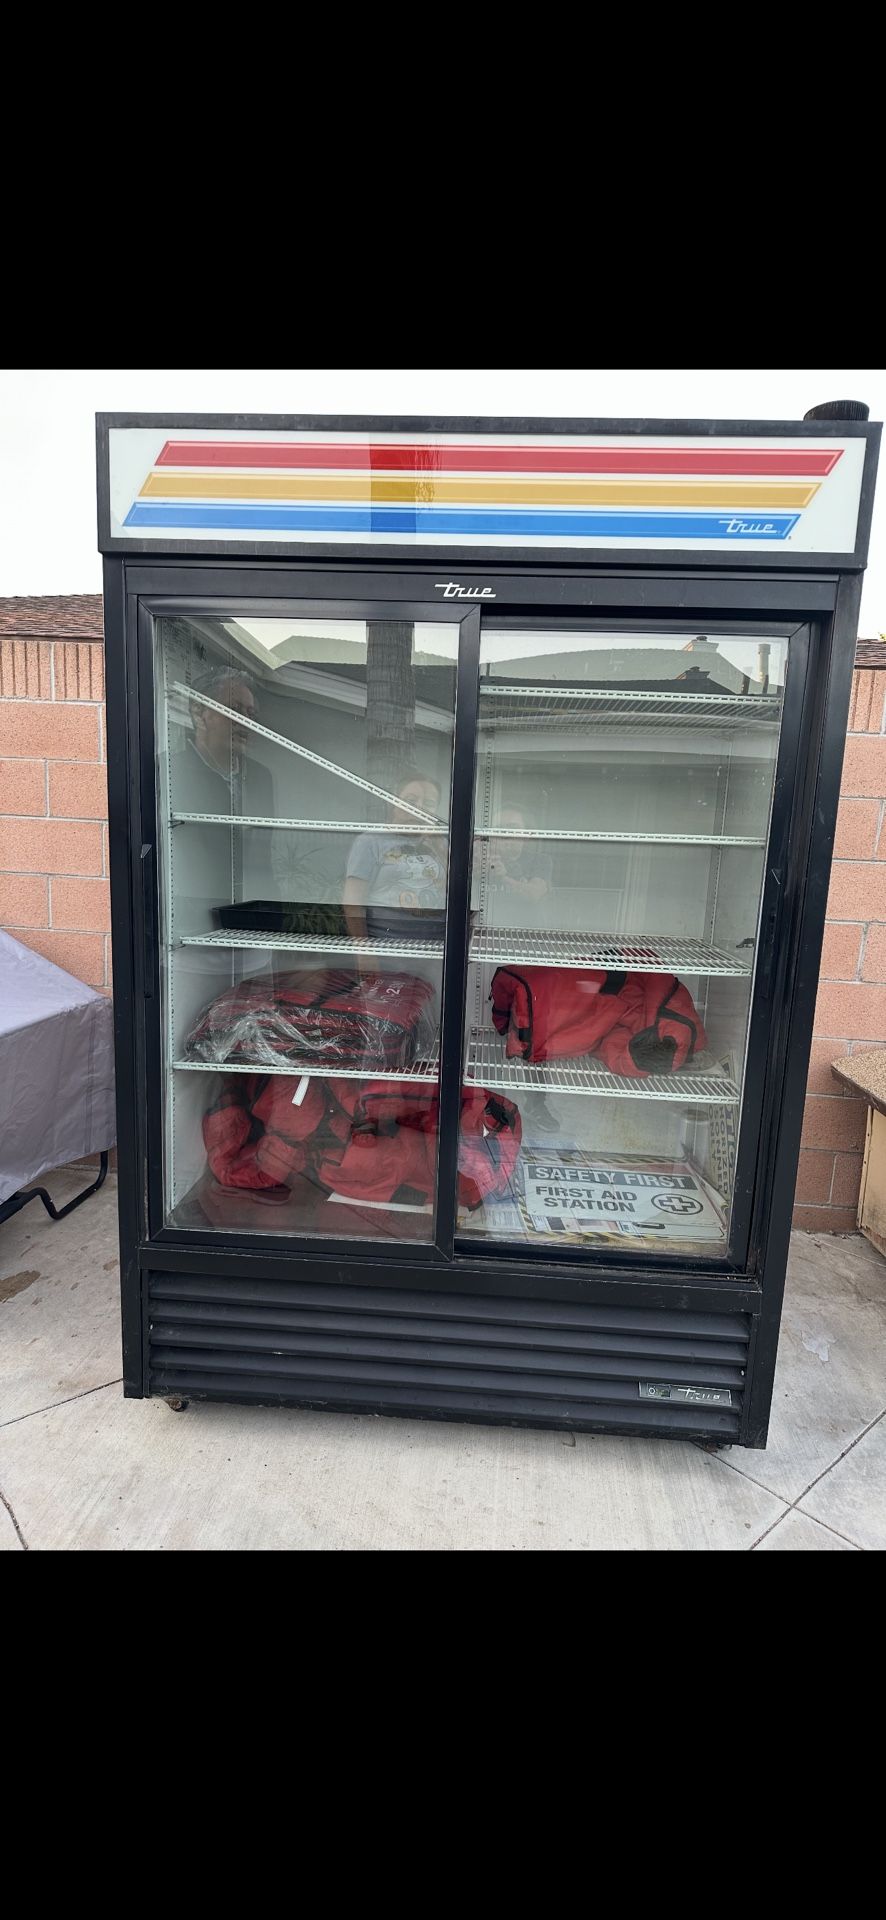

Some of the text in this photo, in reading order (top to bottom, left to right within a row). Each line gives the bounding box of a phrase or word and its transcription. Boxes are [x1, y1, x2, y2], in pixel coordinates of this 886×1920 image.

[535, 1168, 686, 1188] SAFETY FIRST
[535, 1186, 637, 1201] FIRST AID
[543, 1197, 636, 1213] STATION
